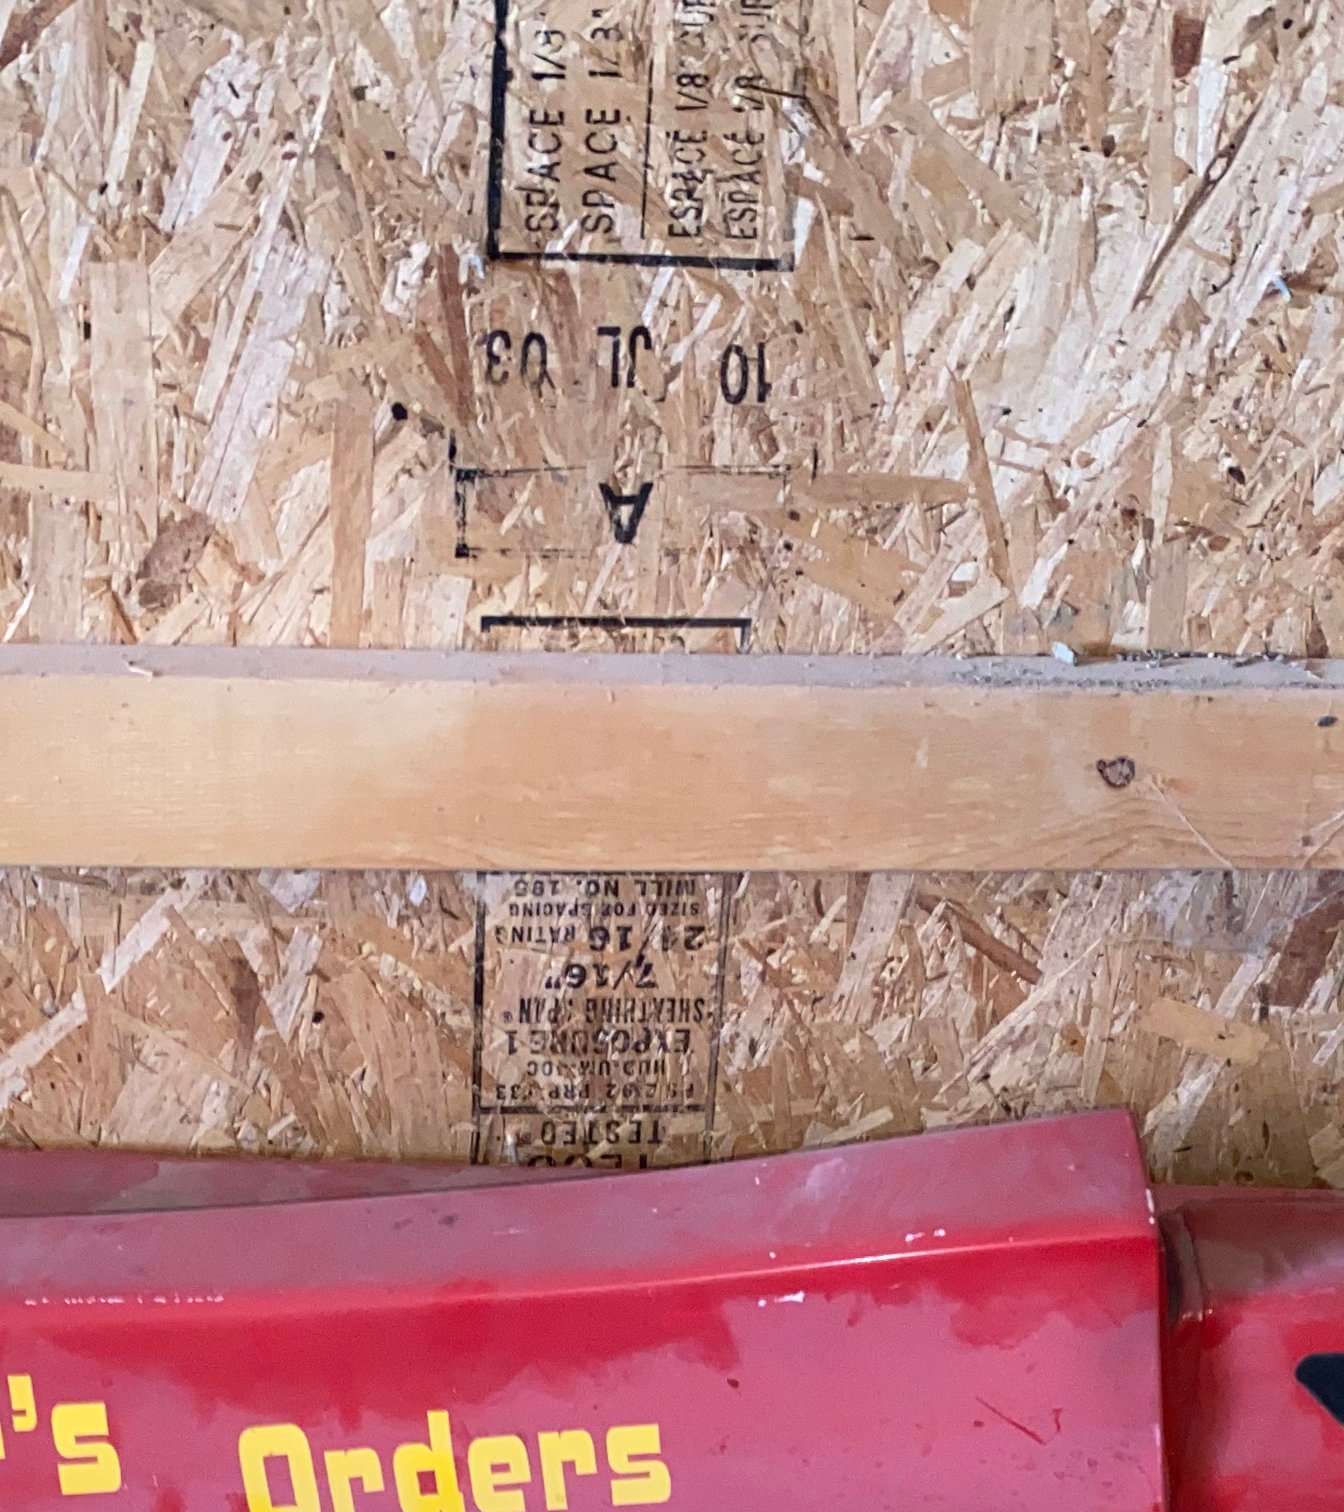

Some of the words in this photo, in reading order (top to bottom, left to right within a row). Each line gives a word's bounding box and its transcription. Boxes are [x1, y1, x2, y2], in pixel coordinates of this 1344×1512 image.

[522, 106, 566, 234] SPACE
[580, 107, 622, 235] SPACE
[719, 341, 772, 405] 10
[598, 480, 654, 546] A
[504, 1030, 520, 1056] 1
